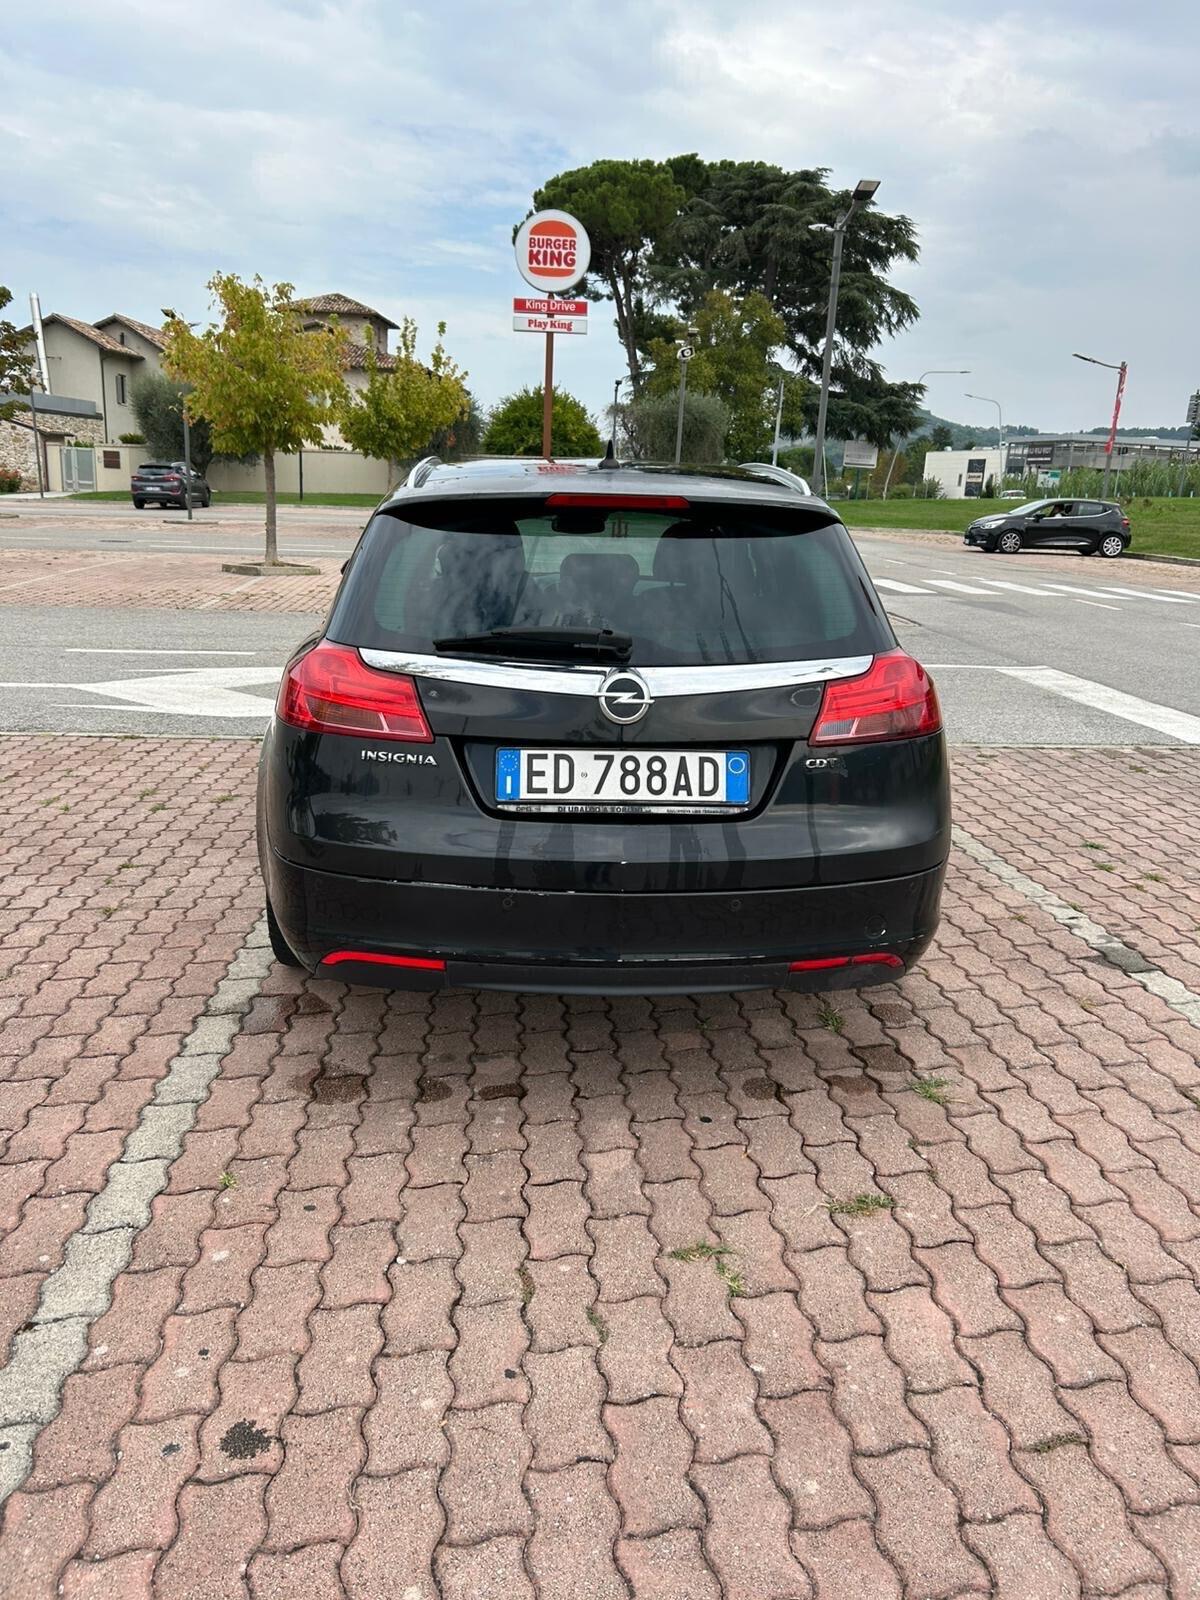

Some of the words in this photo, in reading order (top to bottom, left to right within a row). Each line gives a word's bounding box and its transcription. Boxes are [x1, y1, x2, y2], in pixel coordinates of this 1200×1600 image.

[529, 237, 577, 251] BURGER
[529, 249, 576, 267] KING
[525, 299, 548, 312] King
[550, 301, 576, 312] Drive
[528, 318, 548, 330] Play
[550, 320, 573, 331] King
[361, 750, 437, 766] INSIGNIA
[527, 753, 575, 794] ED
[593, 754, 720, 797] 788AD
